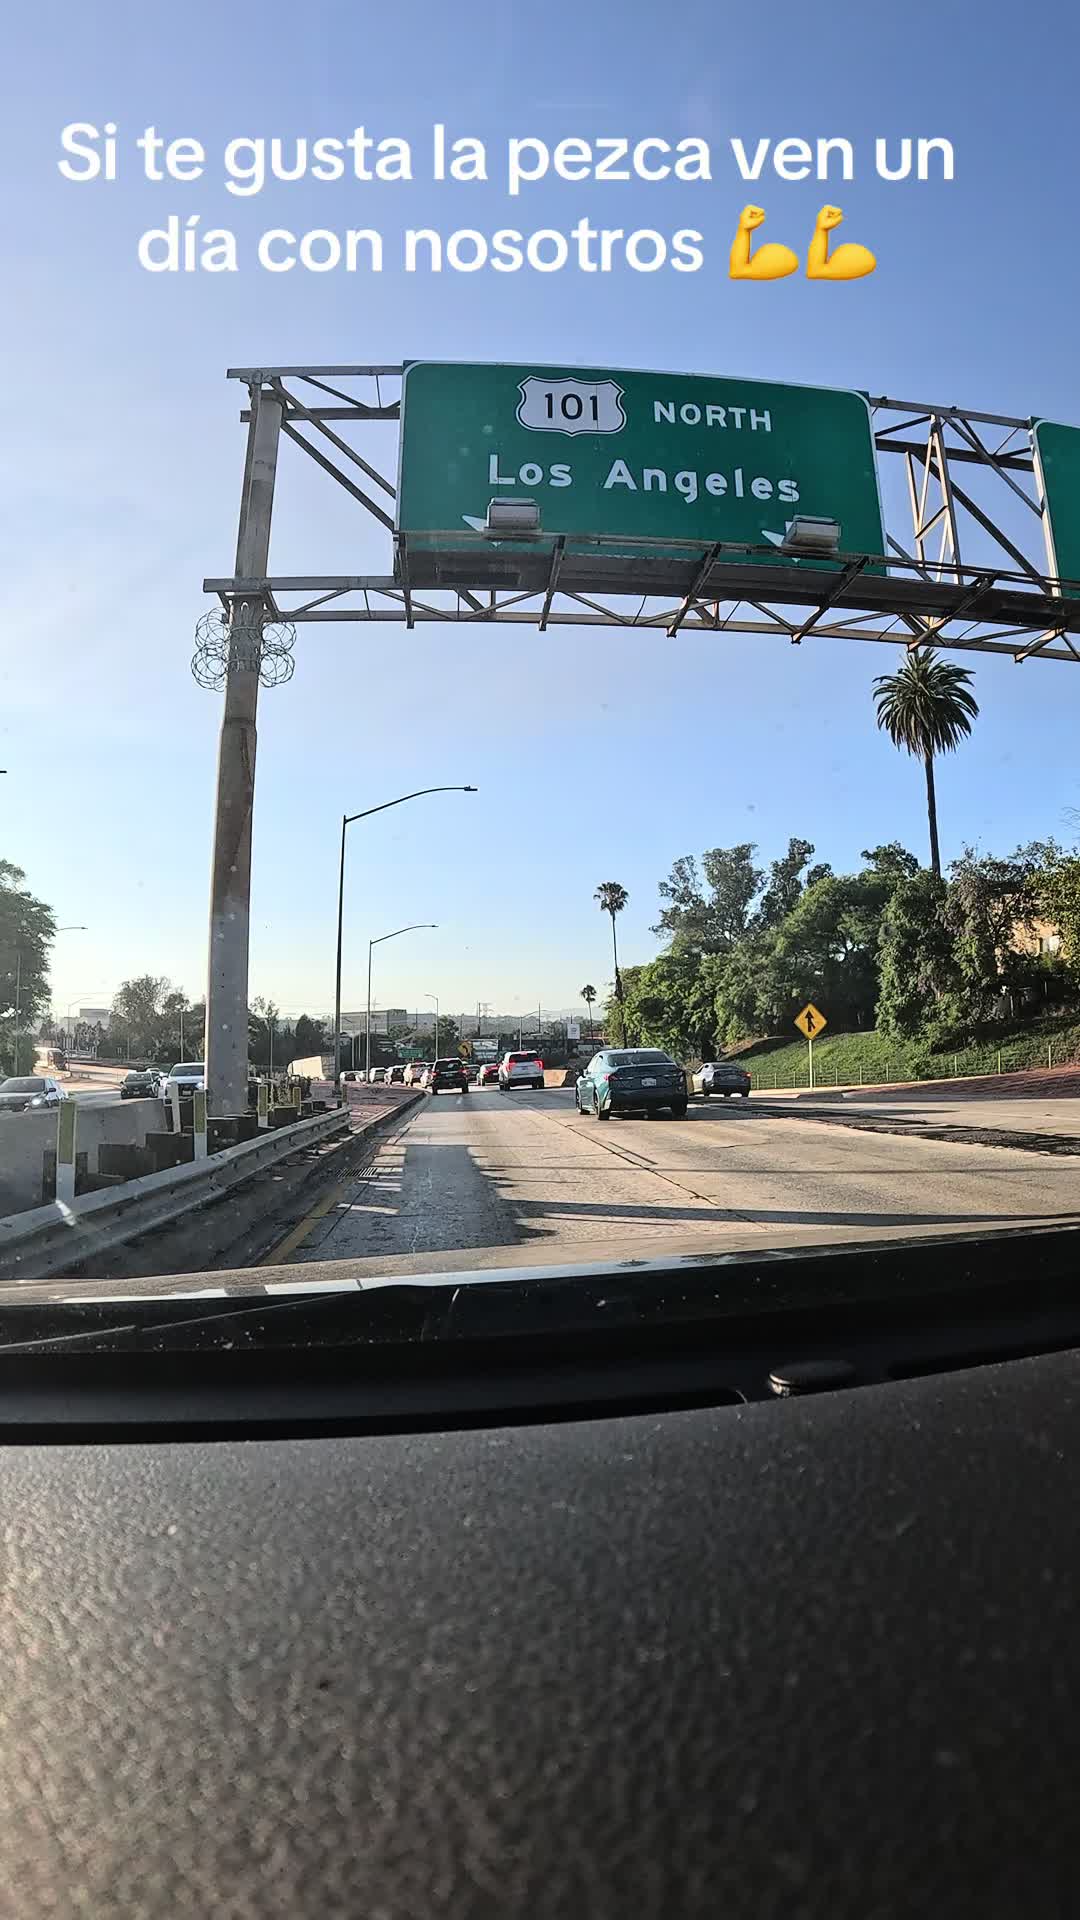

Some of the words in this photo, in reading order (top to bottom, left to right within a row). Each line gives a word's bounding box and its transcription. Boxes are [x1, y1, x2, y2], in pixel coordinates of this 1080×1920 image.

[543, 393, 599, 421] 101
[653, 401, 772, 432] NORTH
[487, 454, 573, 488] Los
[603, 458, 801, 504] Angeles
